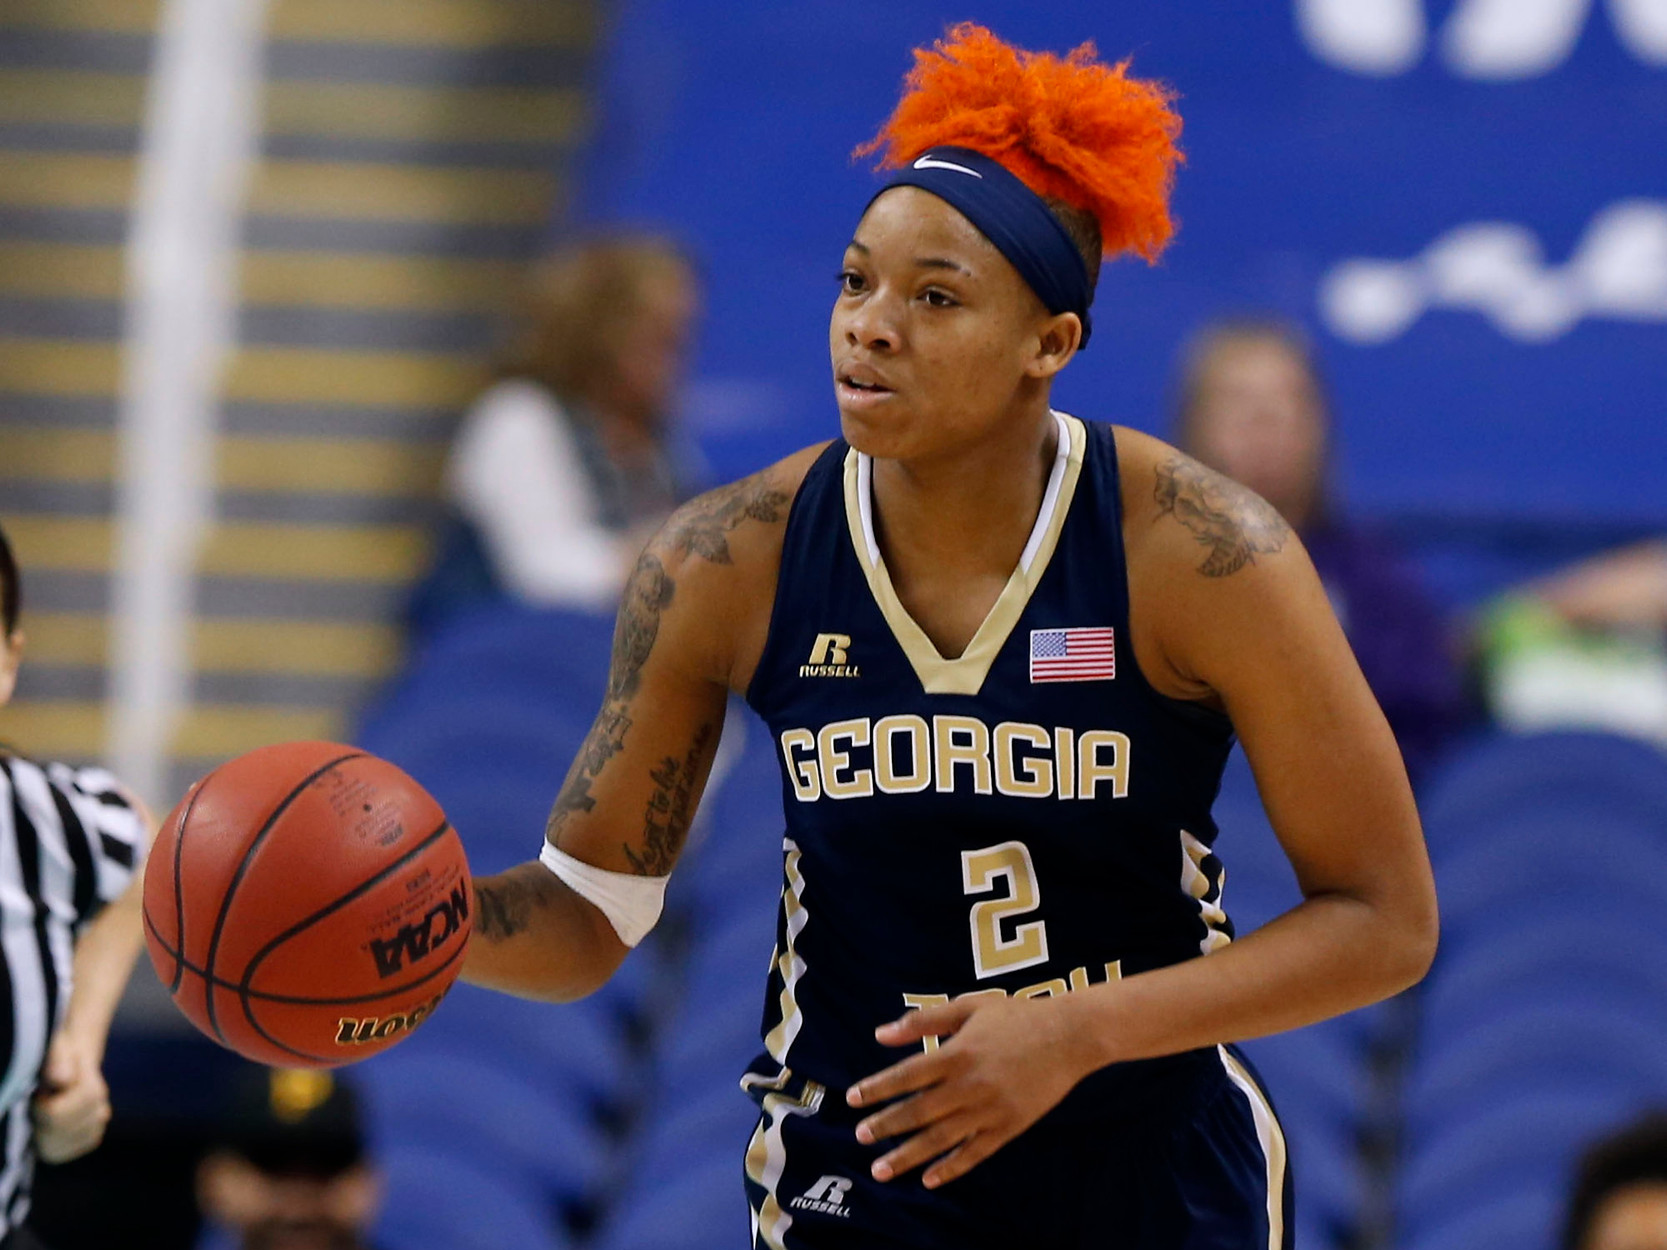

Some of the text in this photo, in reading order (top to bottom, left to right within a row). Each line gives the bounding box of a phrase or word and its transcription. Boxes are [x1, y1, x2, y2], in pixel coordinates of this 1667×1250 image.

[799, 665, 860, 678] RUSSELL
[781, 714, 1131, 802] GEORGIA
[370, 876, 469, 979] NCAA
[961, 840, 1050, 980] 2
[789, 1196, 851, 1218] RUSSELL
